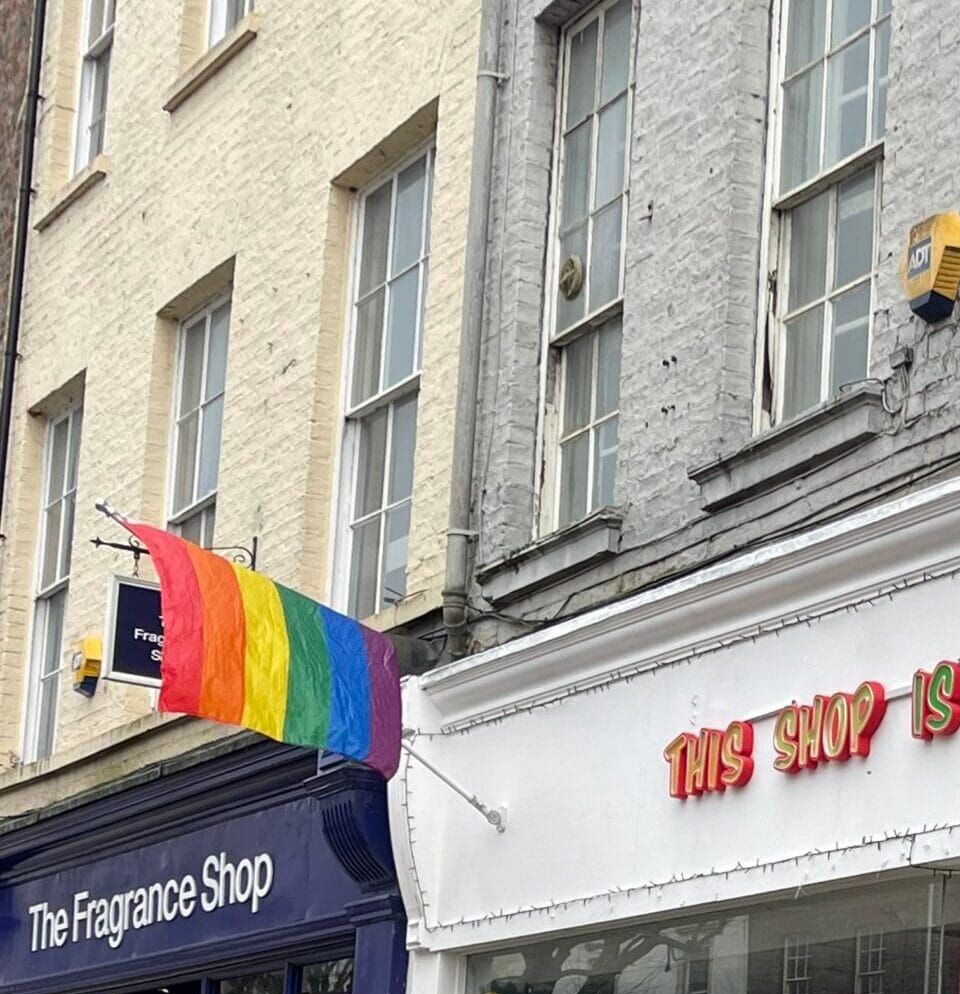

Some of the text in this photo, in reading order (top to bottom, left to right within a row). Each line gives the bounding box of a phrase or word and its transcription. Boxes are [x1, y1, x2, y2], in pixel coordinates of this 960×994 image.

[909, 245, 931, 269] ADT
[663, 720, 754, 799] THIS
[773, 681, 886, 773] SHOP
[29, 851, 273, 951] The Fragrance Shop
